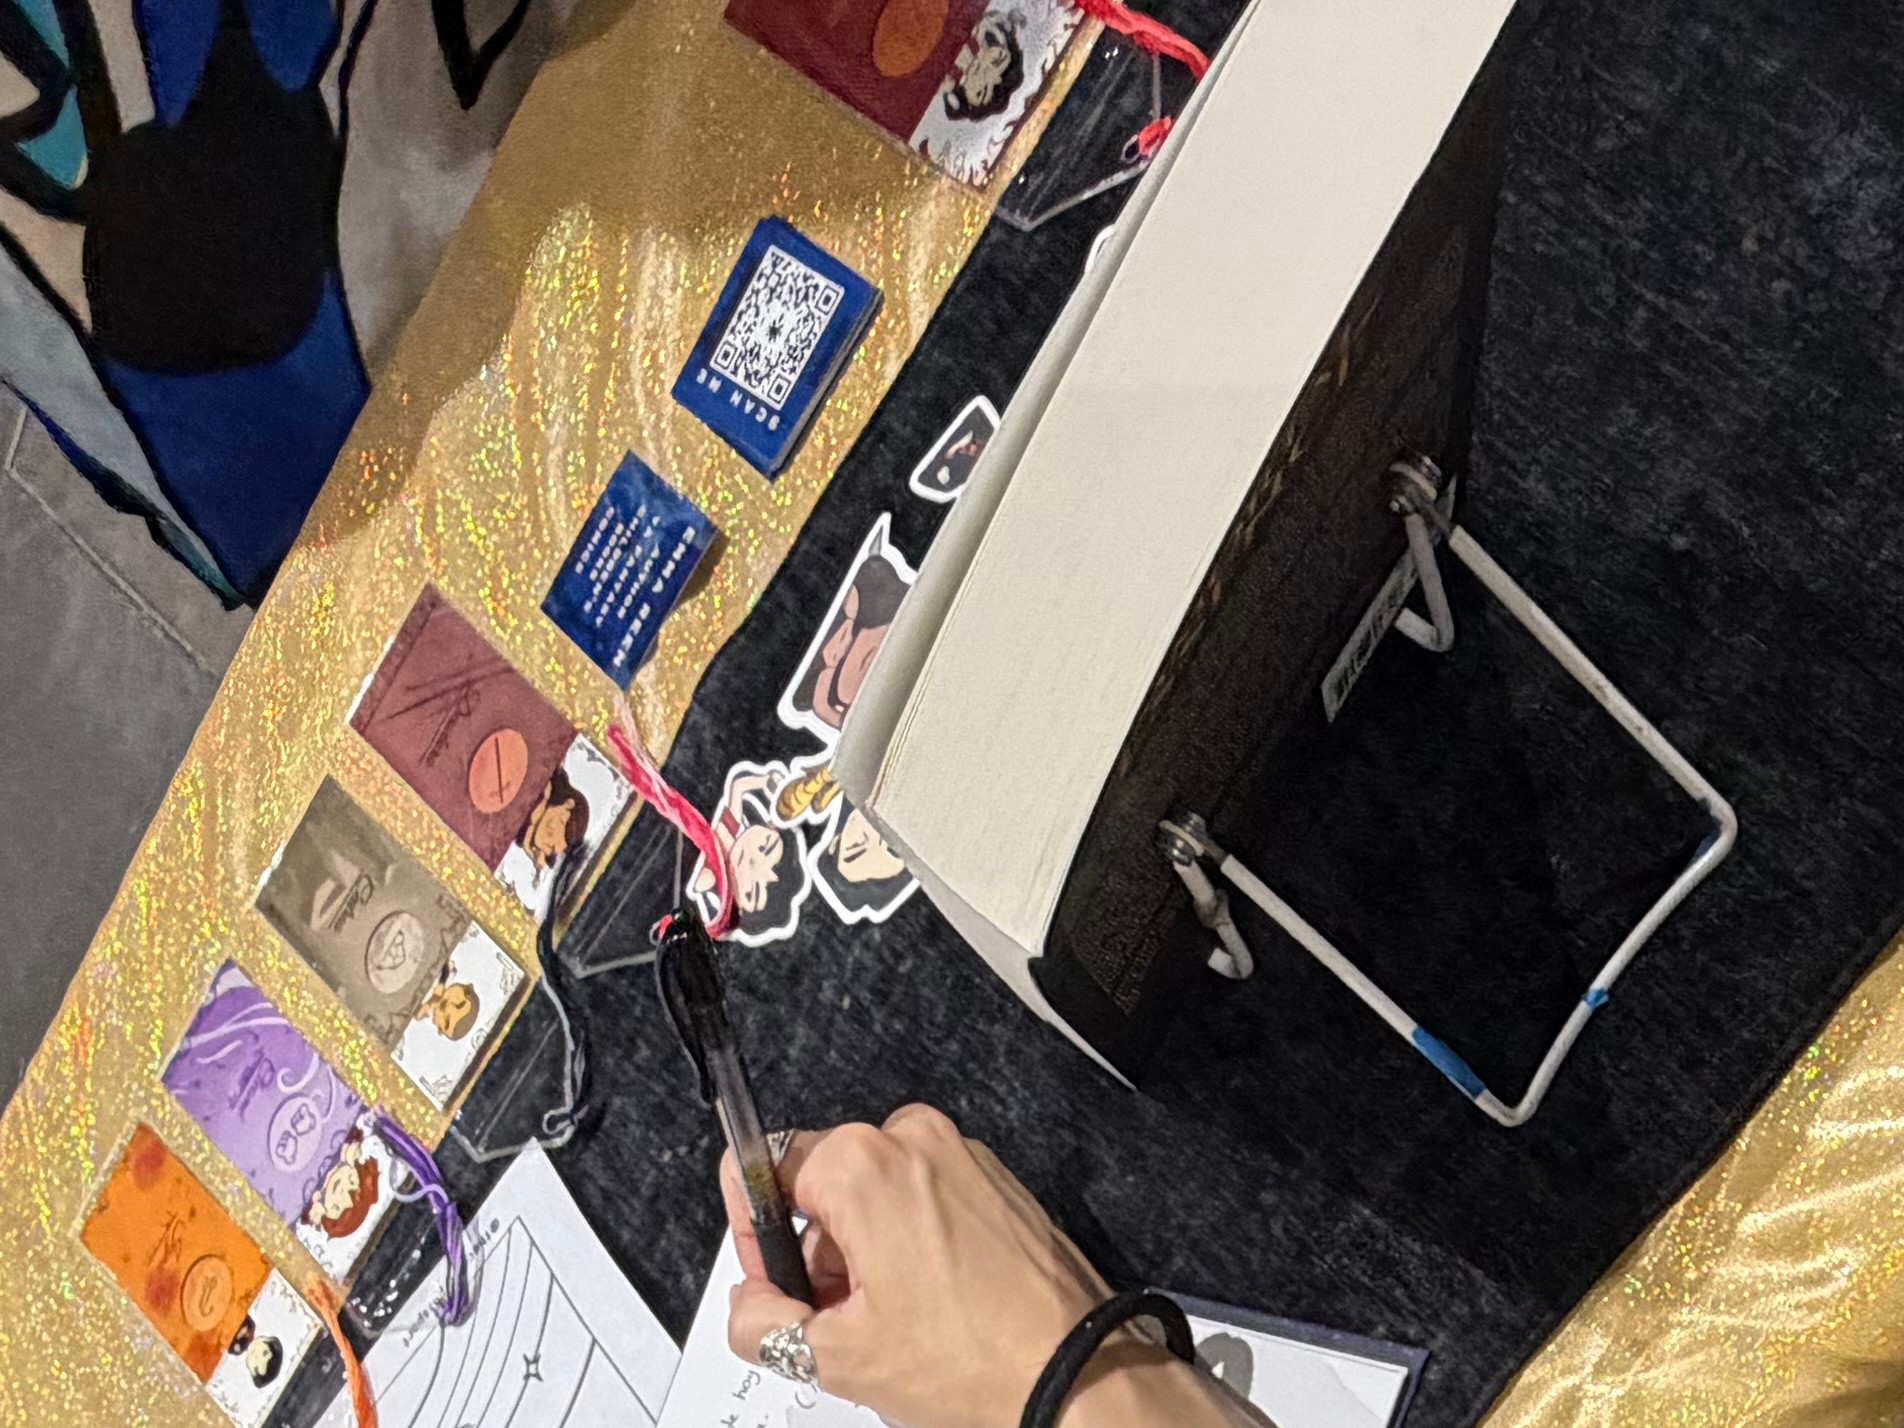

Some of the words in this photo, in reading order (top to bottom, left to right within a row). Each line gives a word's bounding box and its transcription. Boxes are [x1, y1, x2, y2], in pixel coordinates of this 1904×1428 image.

[695, 366, 722, 394] ME
[730, 392, 780, 432] SCAN
[572, 504, 617, 575] COMICS
[587, 521, 626, 582] BOOKS
[641, 513, 661, 542] YA
[591, 543, 643, 628] FANTASY
[614, 543, 663, 620] AUTHOR
[651, 525, 697, 594] EMMA
[611, 603, 651, 668] REEN
[732, 1367, 761, 1401] hoy
